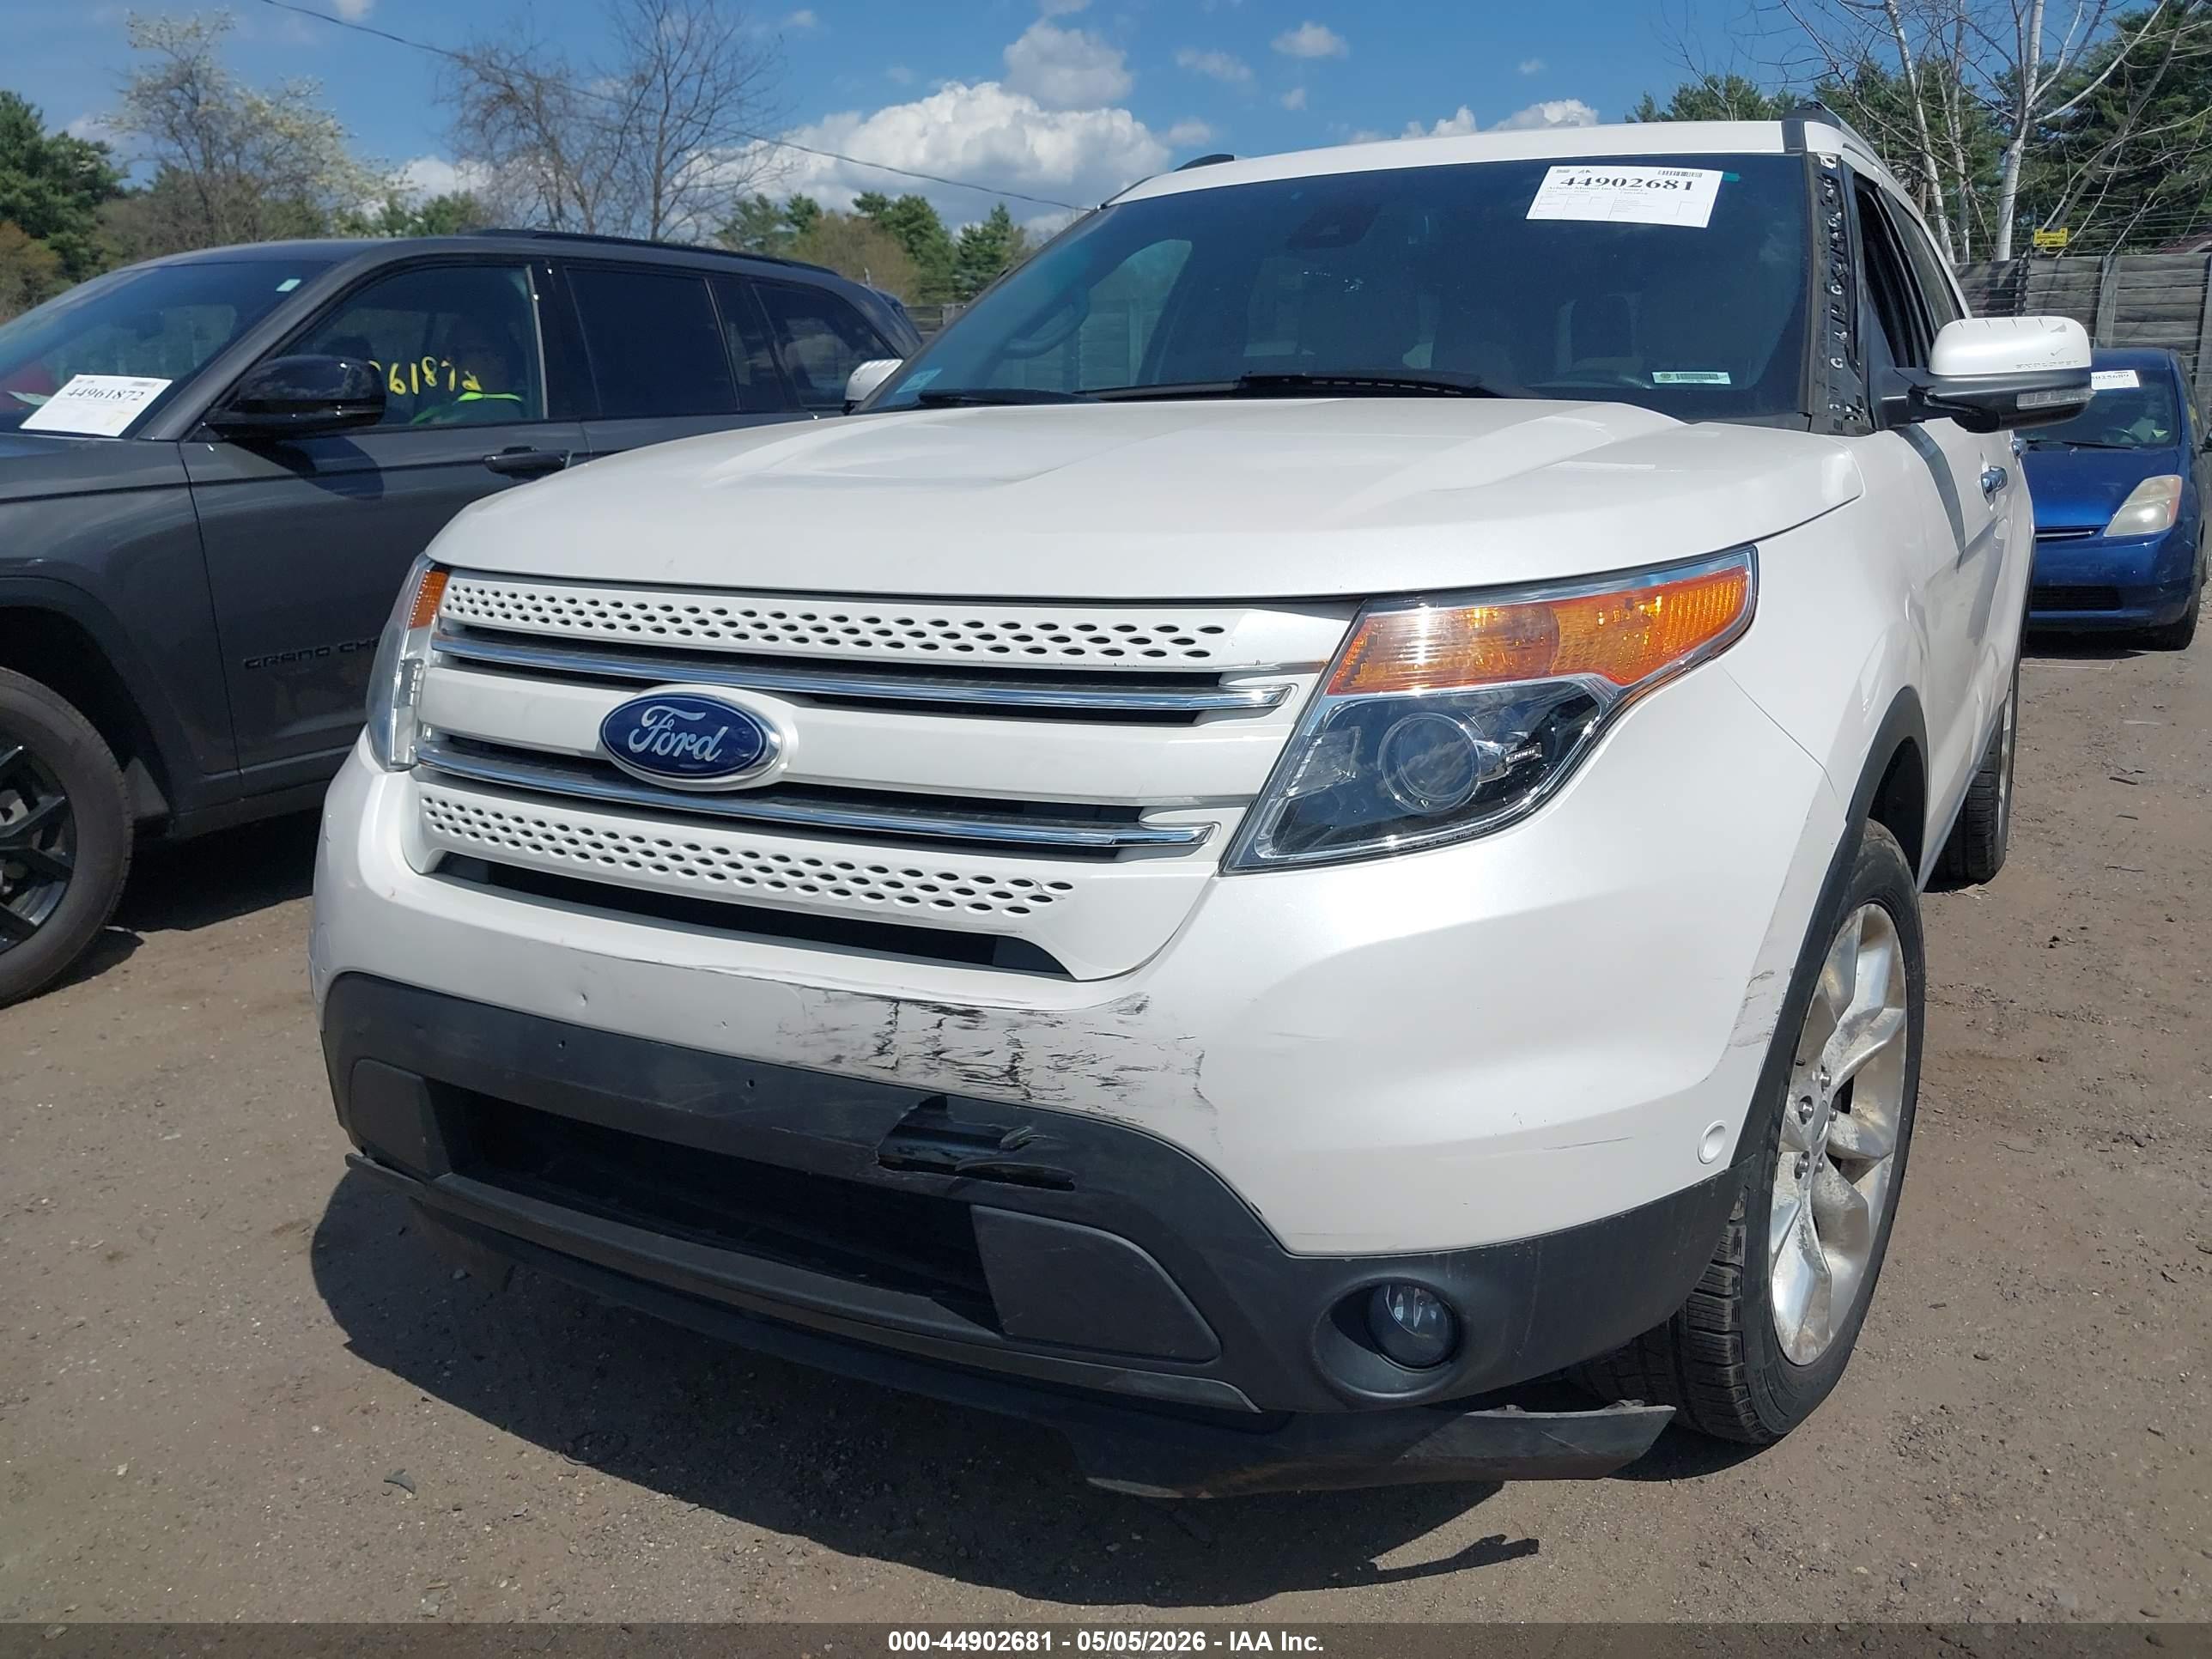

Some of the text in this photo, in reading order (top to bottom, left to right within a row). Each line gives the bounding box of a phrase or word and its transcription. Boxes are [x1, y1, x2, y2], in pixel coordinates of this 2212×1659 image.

[1559, 177, 1693, 191] 44902681
[68, 387, 145, 401] 44961872
[629, 704, 730, 762] Ford
